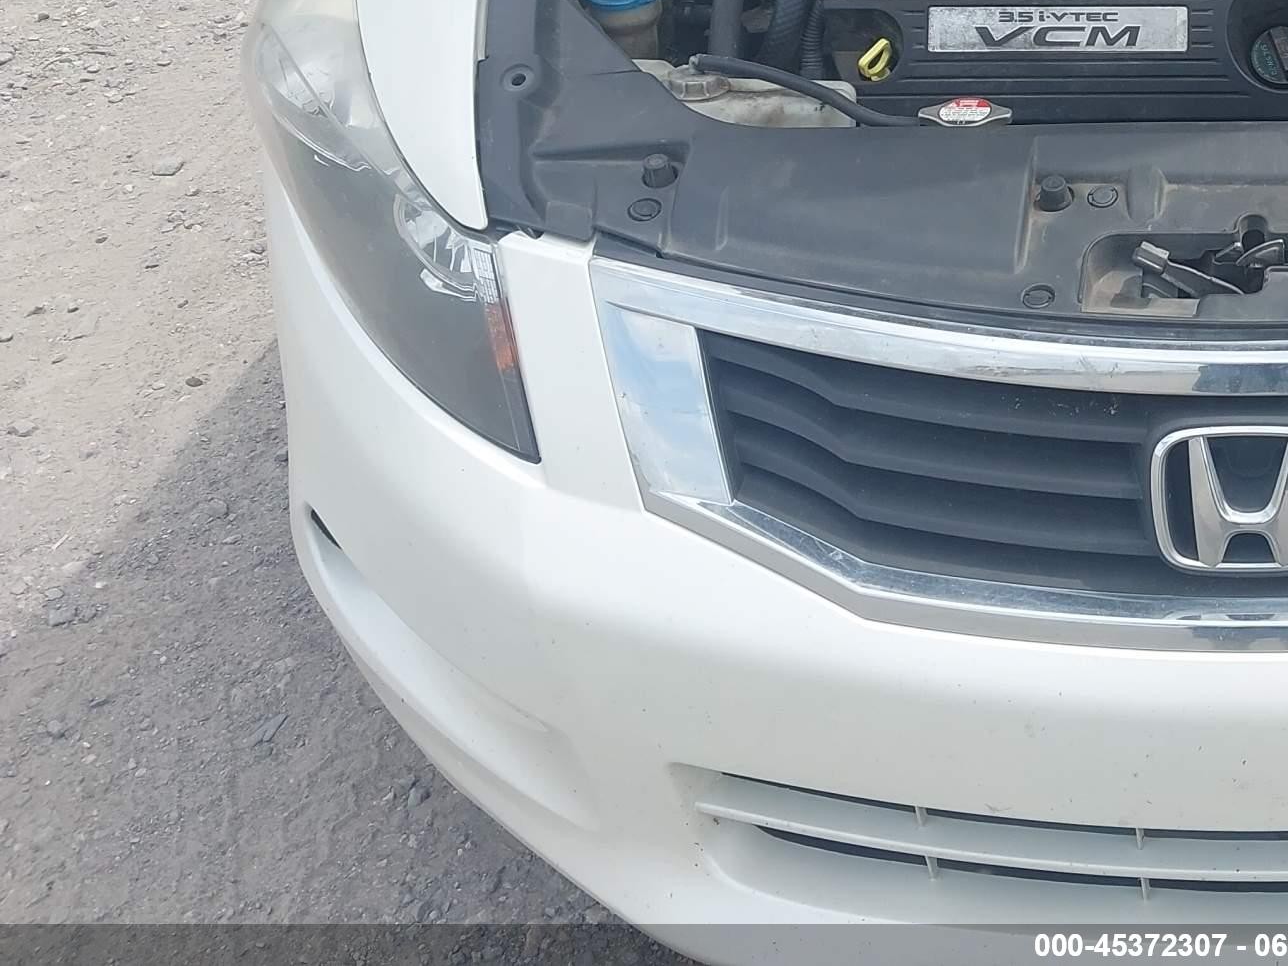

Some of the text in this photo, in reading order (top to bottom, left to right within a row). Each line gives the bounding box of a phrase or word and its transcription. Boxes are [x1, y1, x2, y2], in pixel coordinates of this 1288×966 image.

[998, 11, 1119, 23] 3.5 i-VTEC
[974, 25, 1141, 47] VCM
